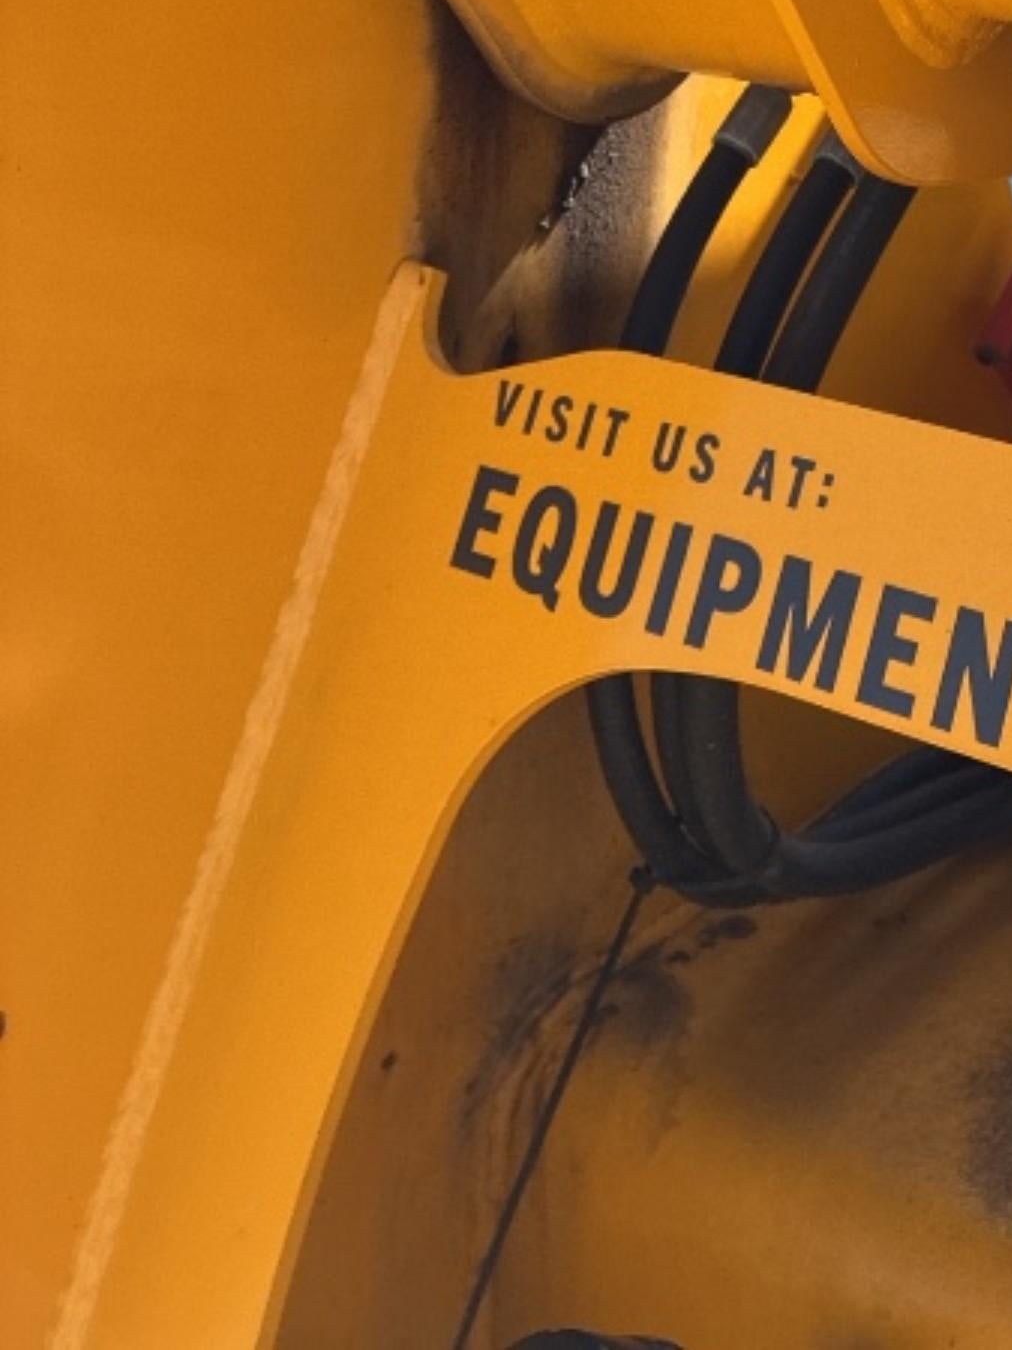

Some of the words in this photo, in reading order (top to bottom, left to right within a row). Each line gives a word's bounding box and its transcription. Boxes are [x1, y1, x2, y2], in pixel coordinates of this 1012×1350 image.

[492, 379, 631, 457] VISIT
[652, 422, 721, 484] US
[744, 448, 836, 510] AT:
